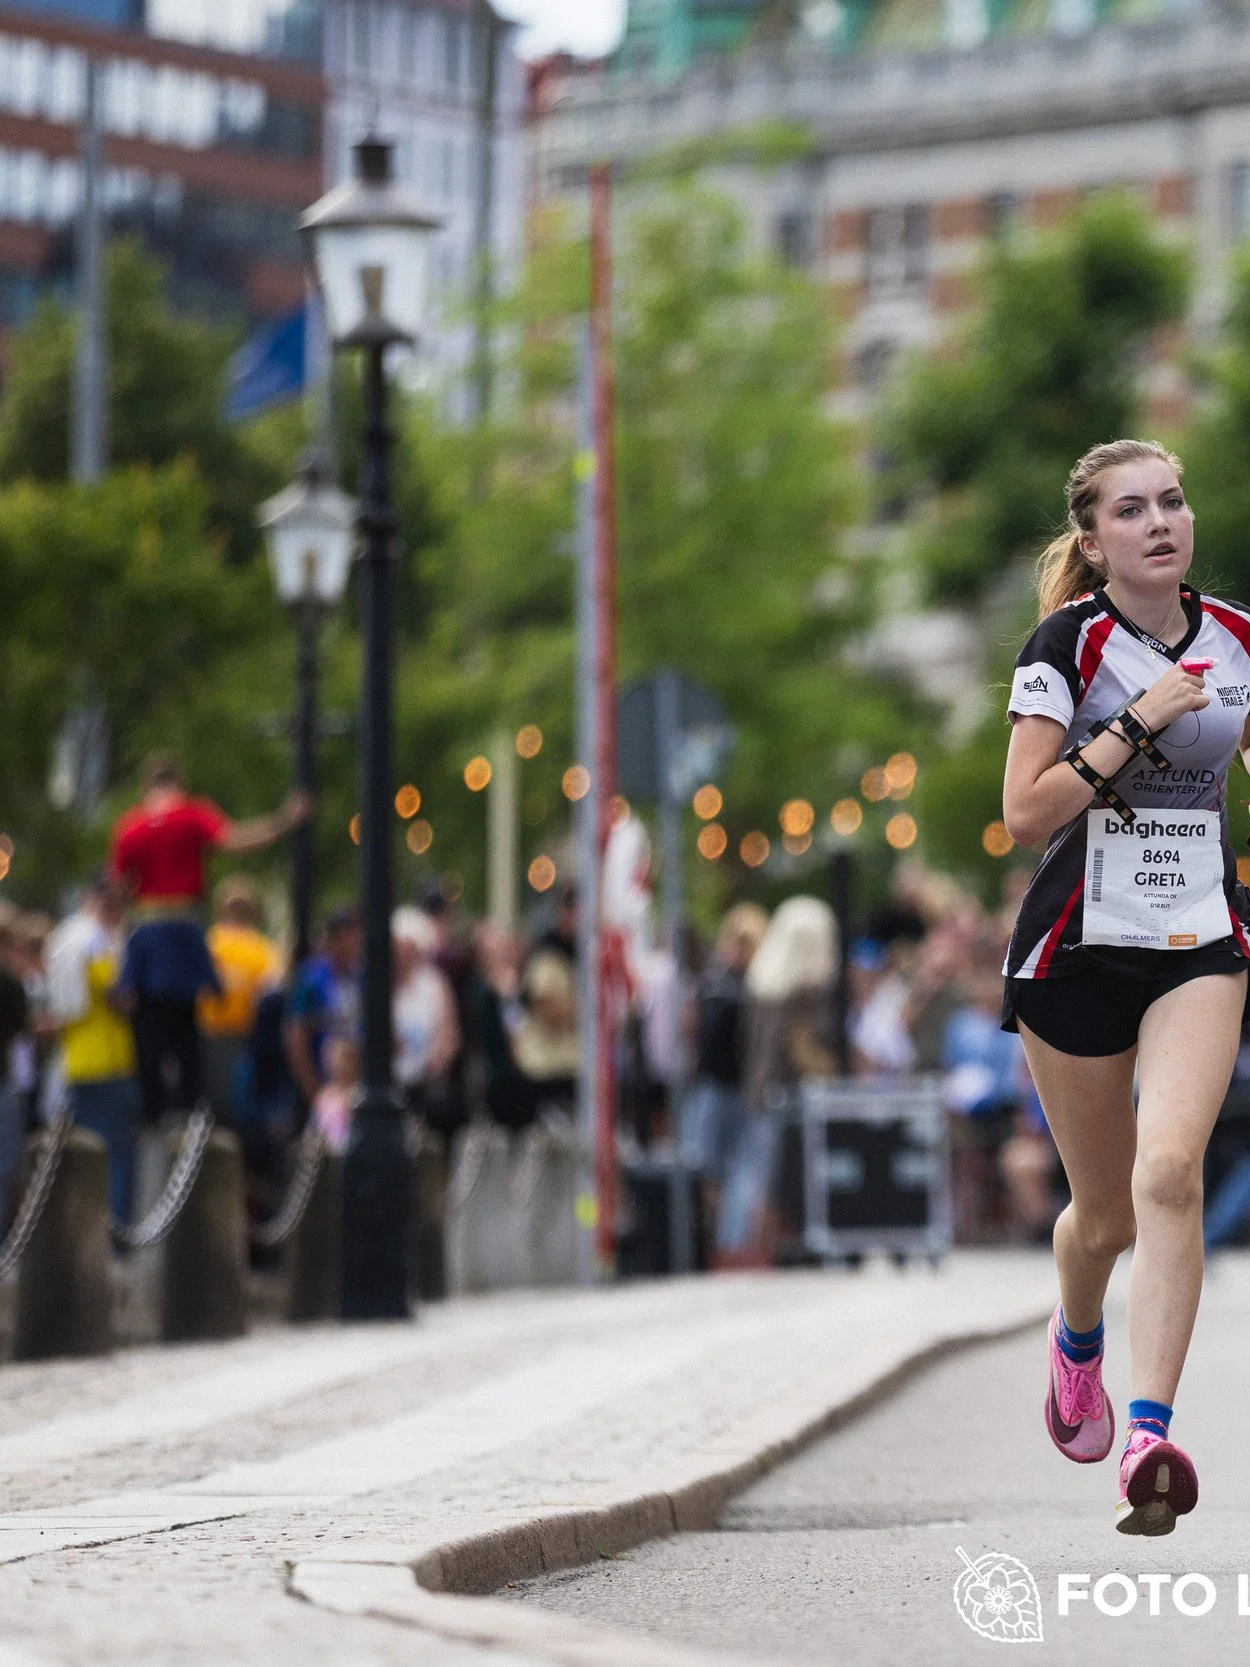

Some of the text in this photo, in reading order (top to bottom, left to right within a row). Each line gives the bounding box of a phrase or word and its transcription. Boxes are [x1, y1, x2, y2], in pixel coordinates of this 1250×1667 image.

[1131, 768, 1216, 784] ATTUND
[1105, 818, 1206, 839] bagheera
[1142, 849, 1181, 864] 8694
[1134, 871, 1186, 887] GRETA
[1120, 934, 1160, 942] CHALMERS
